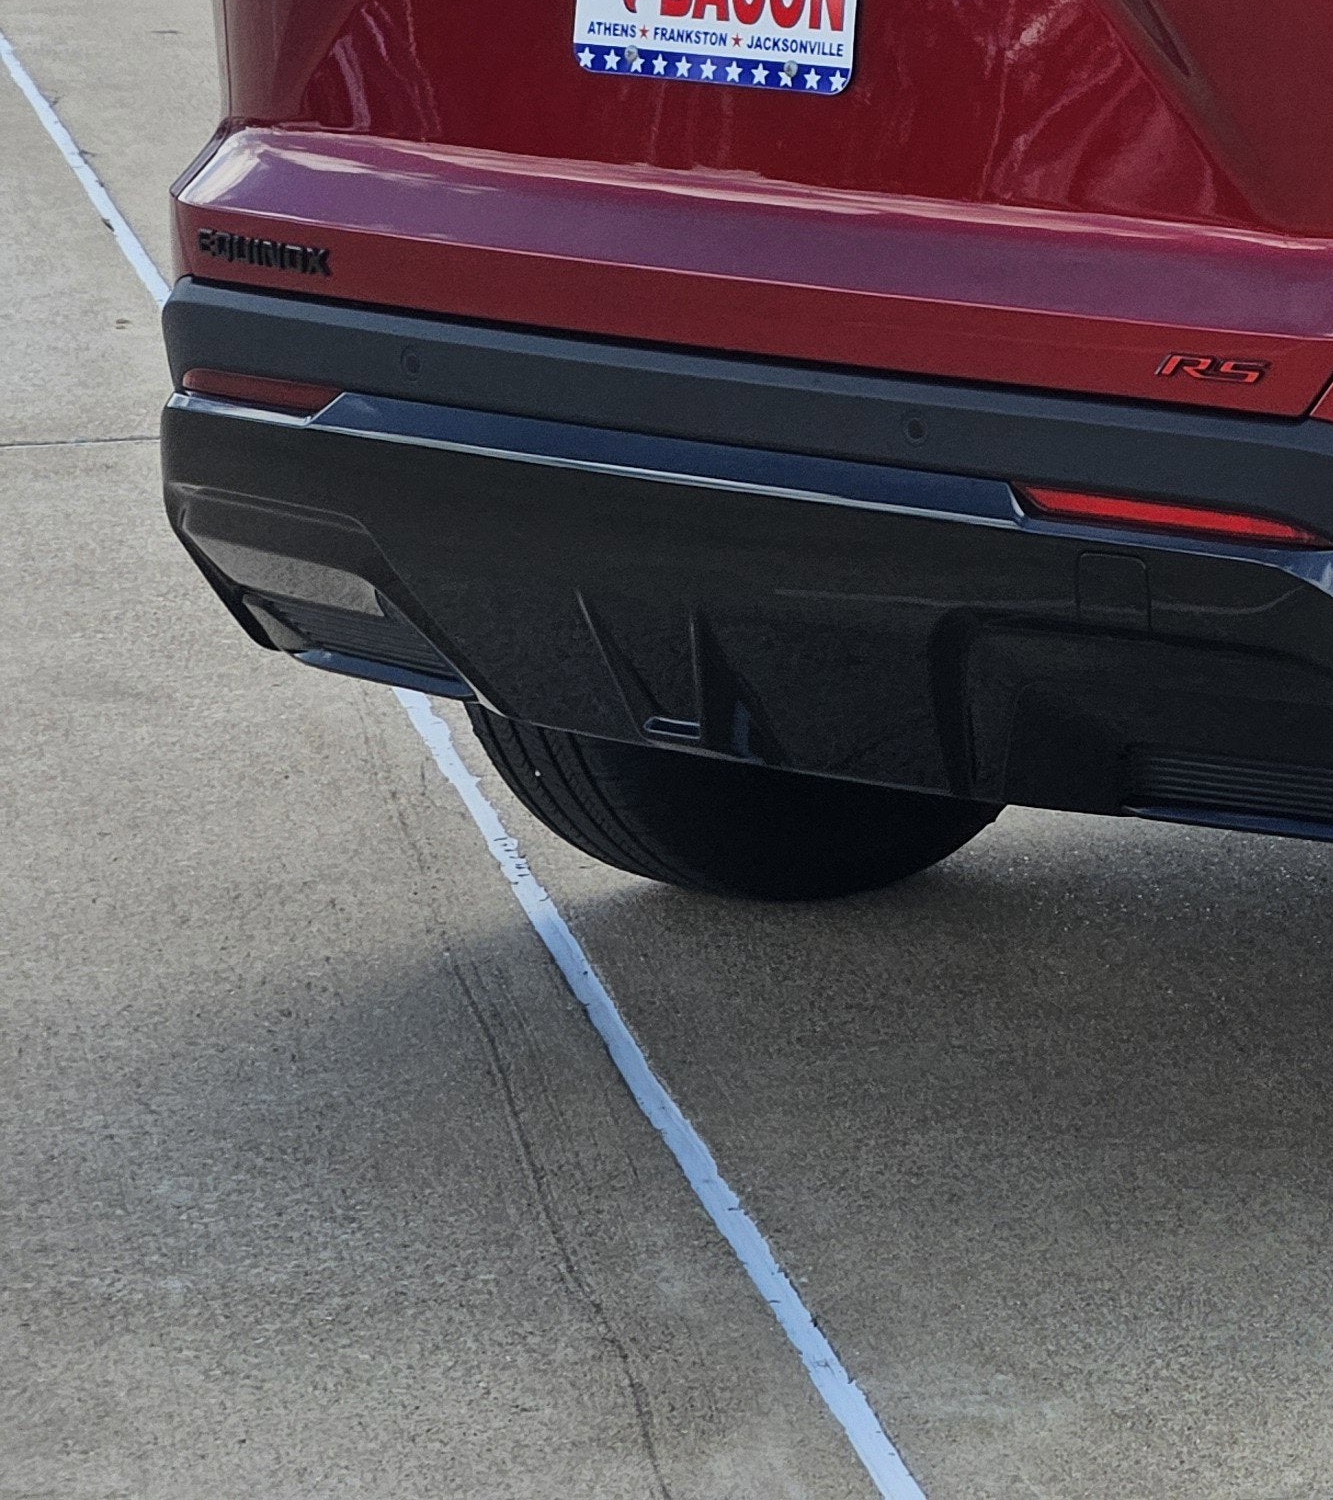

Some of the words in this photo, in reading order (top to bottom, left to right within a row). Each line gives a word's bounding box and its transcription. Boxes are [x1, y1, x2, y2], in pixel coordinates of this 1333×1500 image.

[587, 21, 637, 38] ATHENS
[653, 28, 727, 46] FRANKSTON
[747, 35, 844, 57] JACKSONVILLE
[198, 228, 332, 276] EQUINOX
[1155, 352, 1273, 384] RS
